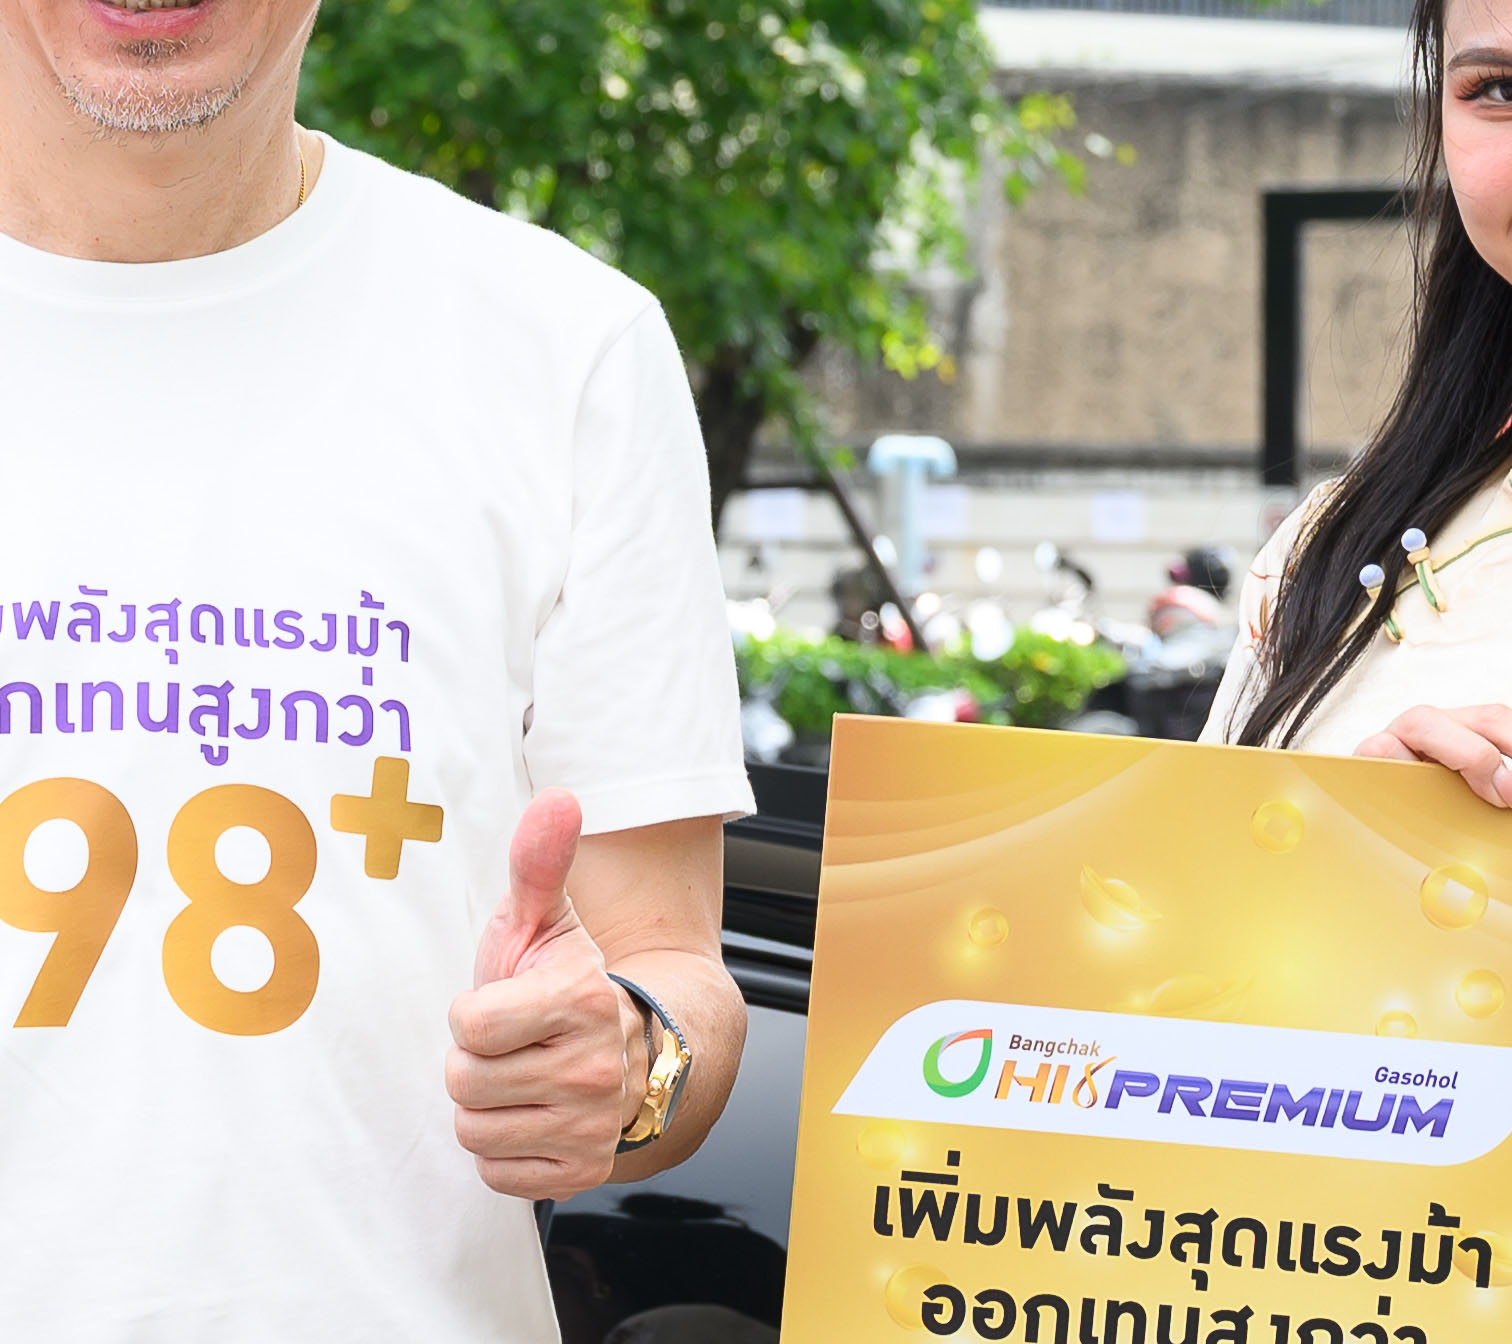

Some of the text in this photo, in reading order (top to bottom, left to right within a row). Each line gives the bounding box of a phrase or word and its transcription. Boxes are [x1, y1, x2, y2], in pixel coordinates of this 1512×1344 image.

[1008, 1034, 1101, 1058] Bangchak
[1374, 1066, 1459, 1090] Gasohol
[1104, 1069, 1455, 1138] PREMIUM
[873, 1150, 1493, 1289] เพิ่มพลังสุดแรงม้า
